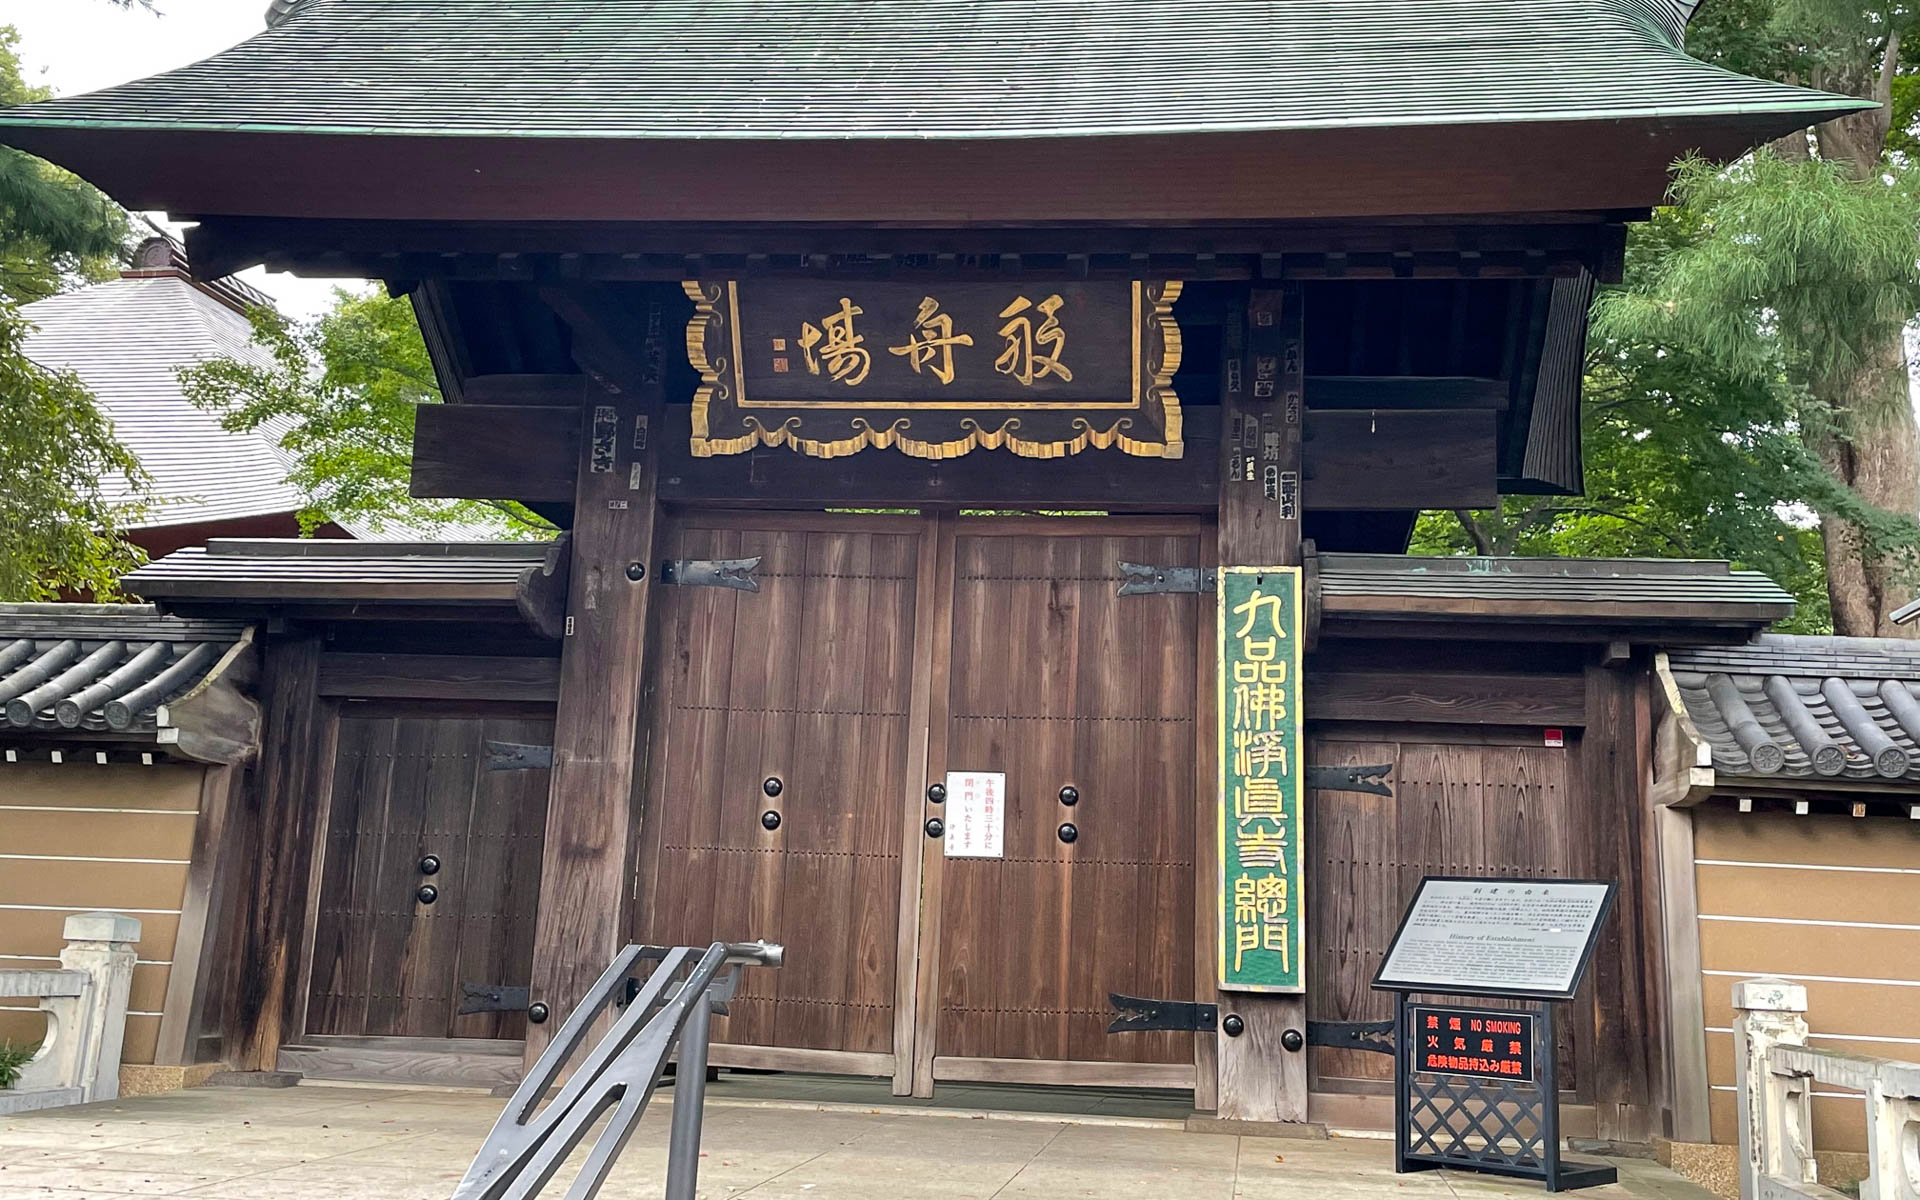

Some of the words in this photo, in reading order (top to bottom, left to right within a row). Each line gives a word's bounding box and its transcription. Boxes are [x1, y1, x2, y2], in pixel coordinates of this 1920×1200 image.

[964, 777, 974, 849] 閉門いたします
[984, 778, 995, 850] 午後四時三十分に
[1449, 933, 1475, 941] History
[1486, 935, 1535, 943] Establishment
[1425, 1015, 1461, 1031] 禁煙
[1470, 1019, 1482, 1032] NO
[1485, 1020, 1521, 1035] SMOKING
[1426, 1035, 1522, 1055] 火気厳禁
[1426, 1054, 1523, 1075] 危険物品持込み厳禁
